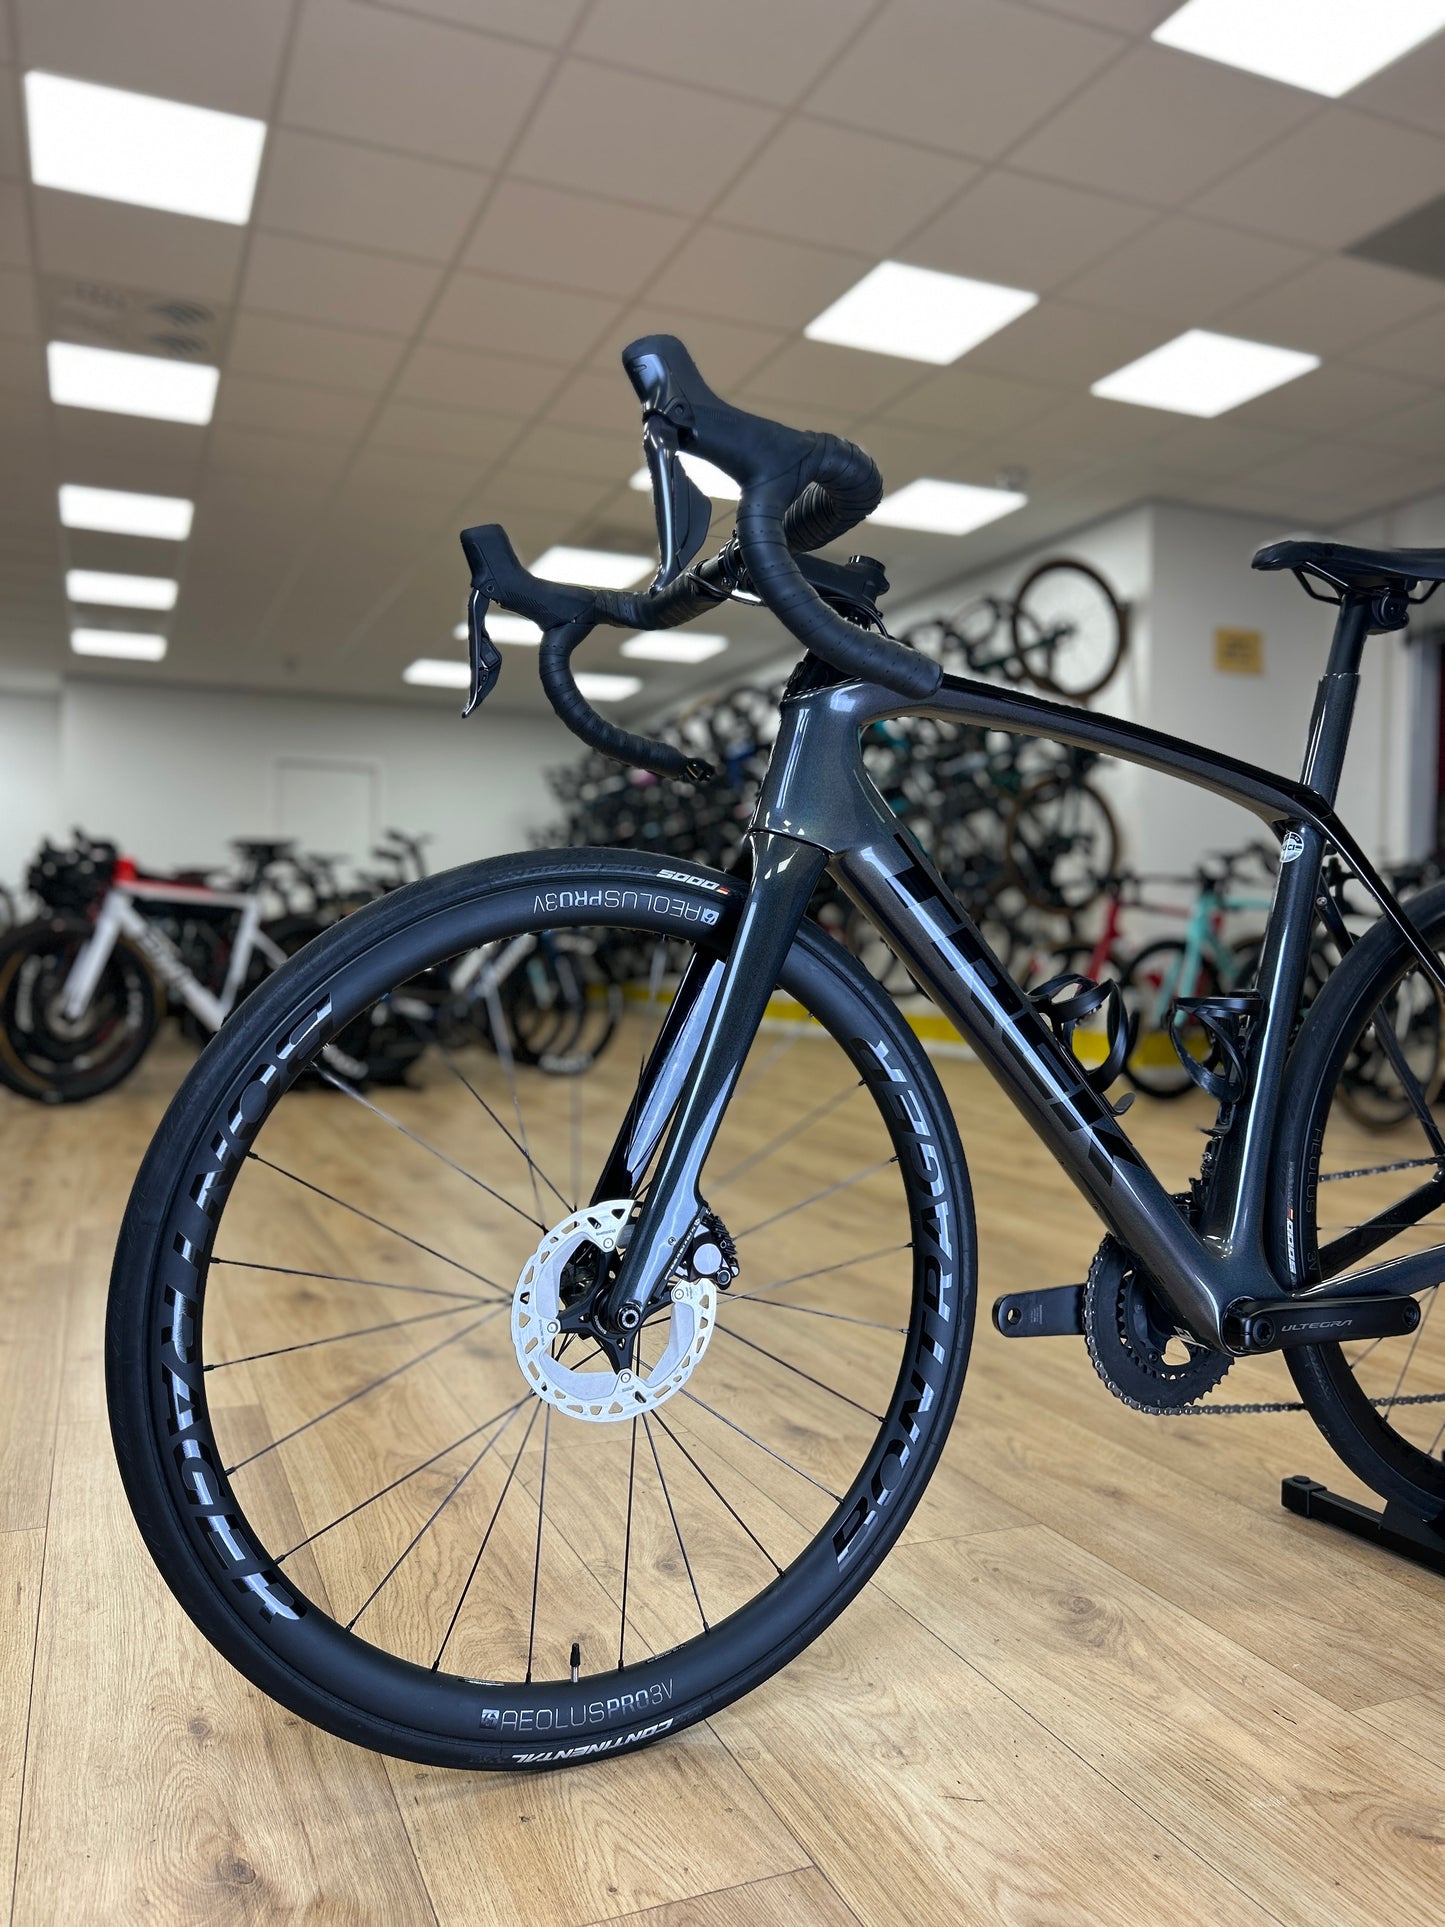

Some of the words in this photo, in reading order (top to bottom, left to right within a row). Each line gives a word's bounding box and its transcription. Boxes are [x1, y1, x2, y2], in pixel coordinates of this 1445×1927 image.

[656, 869, 719, 890] 5000
[885, 833, 1146, 1186] TREK
[160, 992, 334, 1624] BONTRAGER
[833, 1036, 953, 1572] BONTRAGER
[1281, 1319, 1353, 1332] ULTEGRA
[511, 1717, 674, 1764] CONTINENTAL
